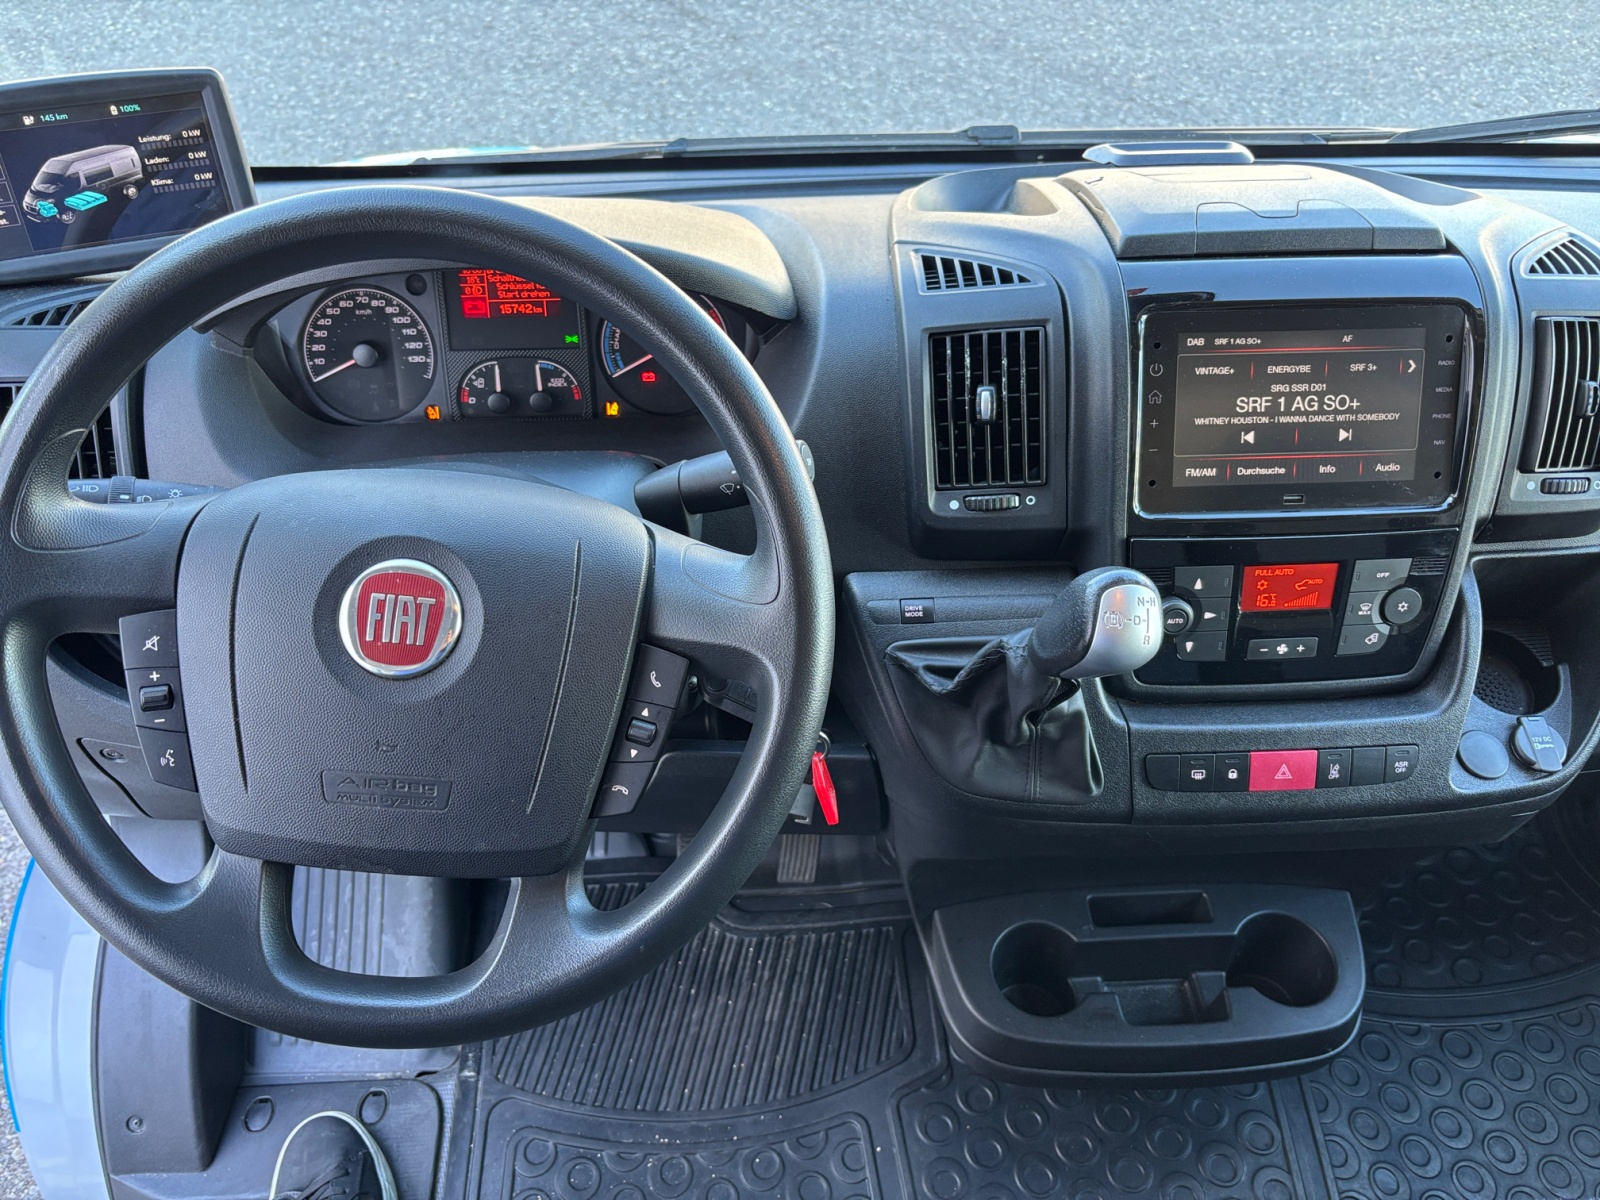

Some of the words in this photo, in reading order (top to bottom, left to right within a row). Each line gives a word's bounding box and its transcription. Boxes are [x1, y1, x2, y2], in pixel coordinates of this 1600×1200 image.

[120, 104, 141, 113] 100%
[40, 114, 55, 122] 145
[138, 134, 172, 143] Leistung:
[182, 130, 188, 138] 0
[145, 157, 169, 165] Laden:
[200, 172, 212, 180] kW
[521, 290, 550, 298] drehen
[500, 304, 532, 314] 15742
[1187, 338, 1205, 346] DAB
[1246, 337, 1262, 345] SO+
[1342, 335, 1353, 343] AF
[1195, 367, 1235, 375] VINTAGE+
[1267, 365, 1312, 374] ENERGYBE
[1350, 364, 1366, 372] SRF
[1368, 363, 1377, 371] 3+
[1270, 384, 1290, 392] SRG
[1291, 384, 1309, 392] SSR
[1310, 383, 1327, 391] D01
[1235, 396, 1272, 413] SRF
[1278, 397, 1285, 412] 1
[1291, 395, 1319, 411] AG
[1323, 394, 1361, 411] SO+
[1194, 417, 1230, 426] WHITNEY
[1231, 416, 1269, 425] HOUSTON
[1278, 415, 1307, 423] WANNA
[1308, 414, 1335, 422] DANCE
[1336, 414, 1355, 422] WITH
[1357, 412, 1401, 421] SOMEBODY
[1237, 466, 1286, 476] Durchsuche
[1319, 464, 1336, 473] Info
[1375, 463, 1401, 472] Audio
[1186, 468, 1216, 477] FM/AM
[366, 592, 436, 646] FIAT
[1133, 615, 1141, 626] D
[1143, 635, 1150, 645] R
